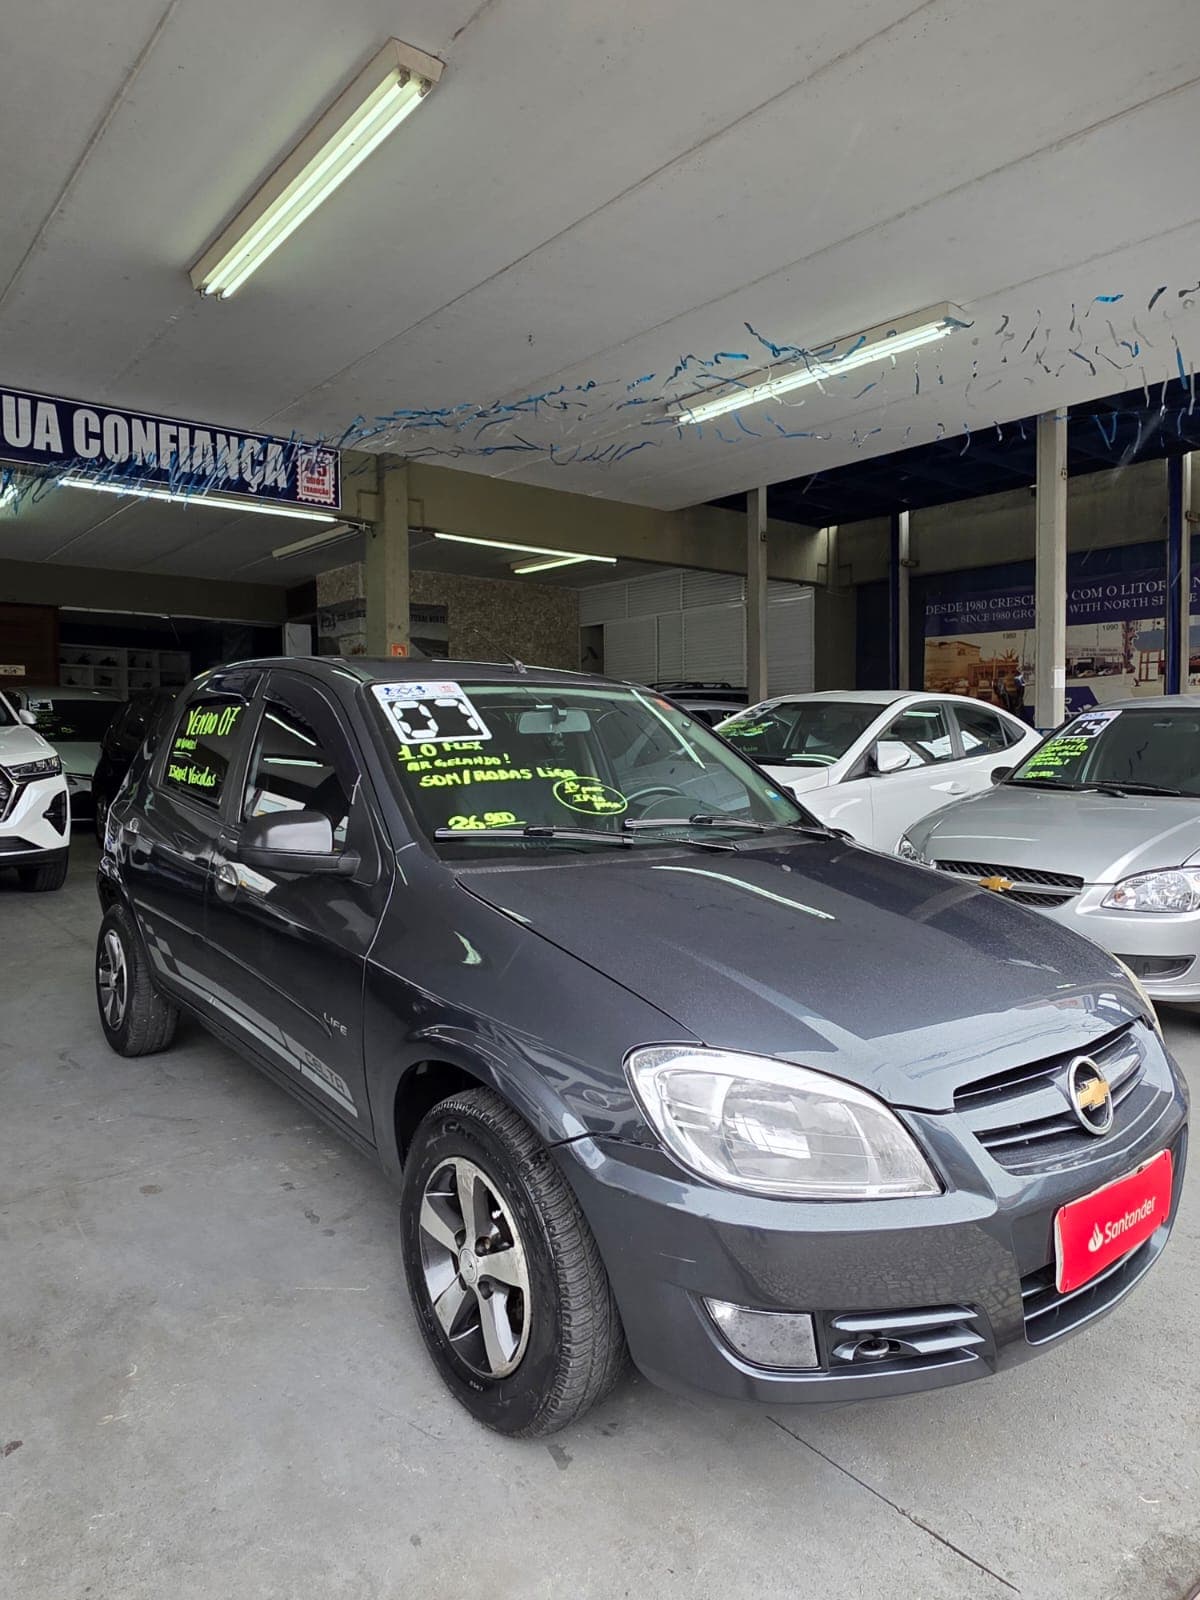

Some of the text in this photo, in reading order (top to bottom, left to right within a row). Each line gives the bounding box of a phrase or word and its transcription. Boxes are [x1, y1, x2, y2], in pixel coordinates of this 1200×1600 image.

[2, 394, 288, 493] UA CONFIANÇA
[925, 602, 963, 616] DESDE
[966, 600, 988, 612] 1980
[1071, 587, 1103, 601] COM
[1106, 585, 1118, 596] O
[960, 613, 990, 624] SINCE
[992, 611, 1011, 622] 1980
[1069, 602, 1101, 614] WITH
[1103, 597, 1149, 610] NORTH
[323, 1012, 348, 1036] LIFE
[1104, 1196, 1156, 1245] Santander
